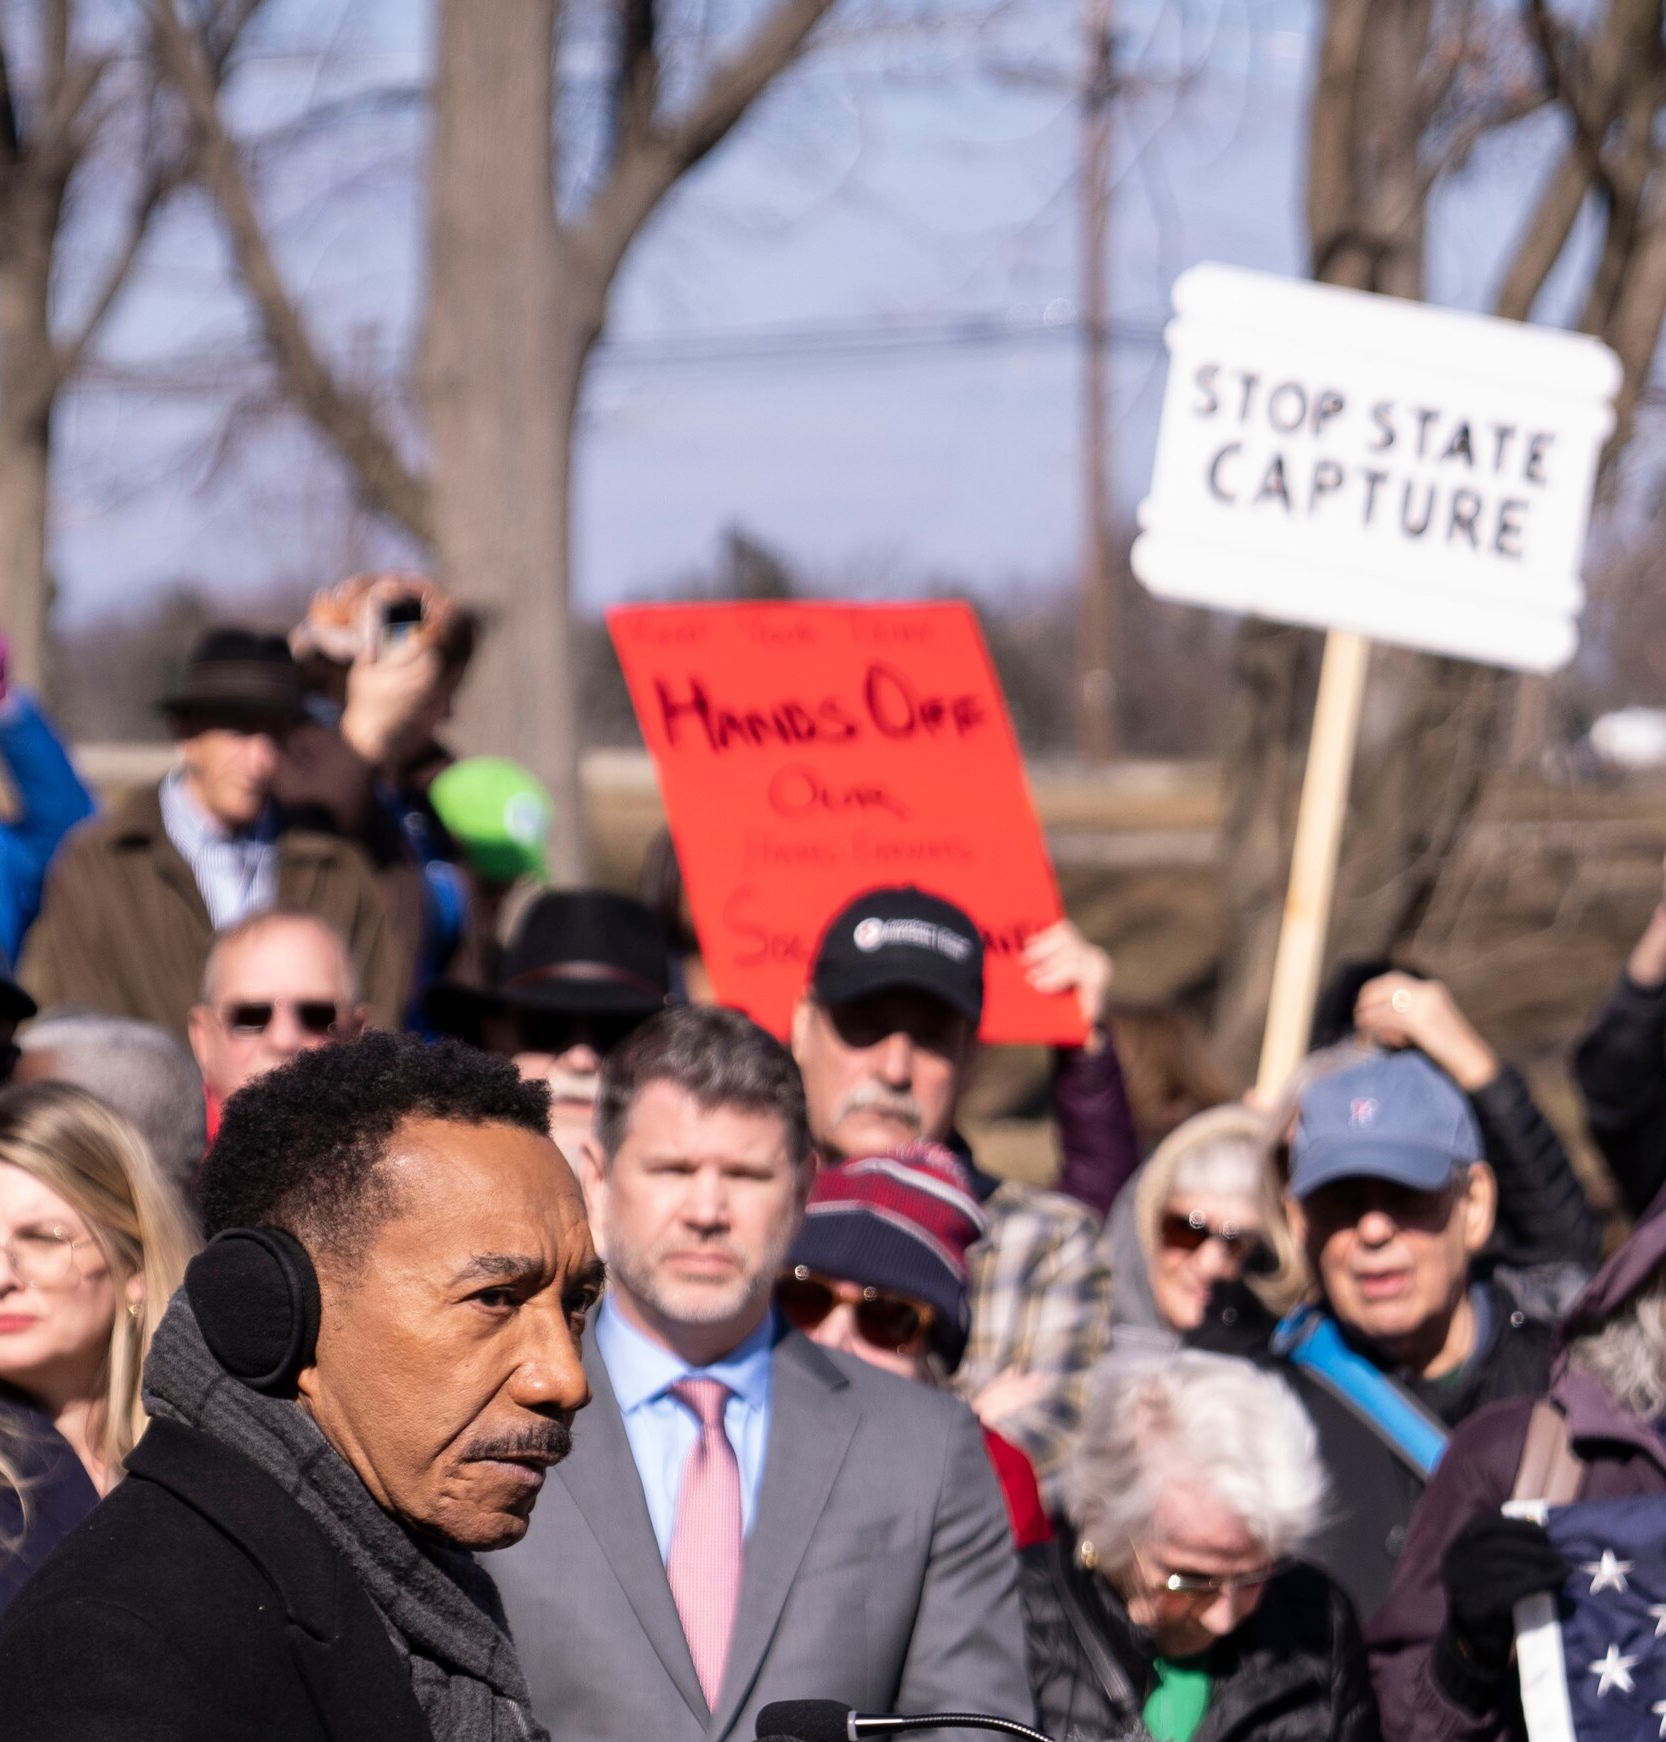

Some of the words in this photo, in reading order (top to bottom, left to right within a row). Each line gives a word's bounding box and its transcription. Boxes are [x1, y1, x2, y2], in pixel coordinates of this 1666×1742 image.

[1194, 364, 1345, 436] STOP
[1368, 400, 1555, 487] STATE
[1208, 441, 1529, 560] CAPTURE
